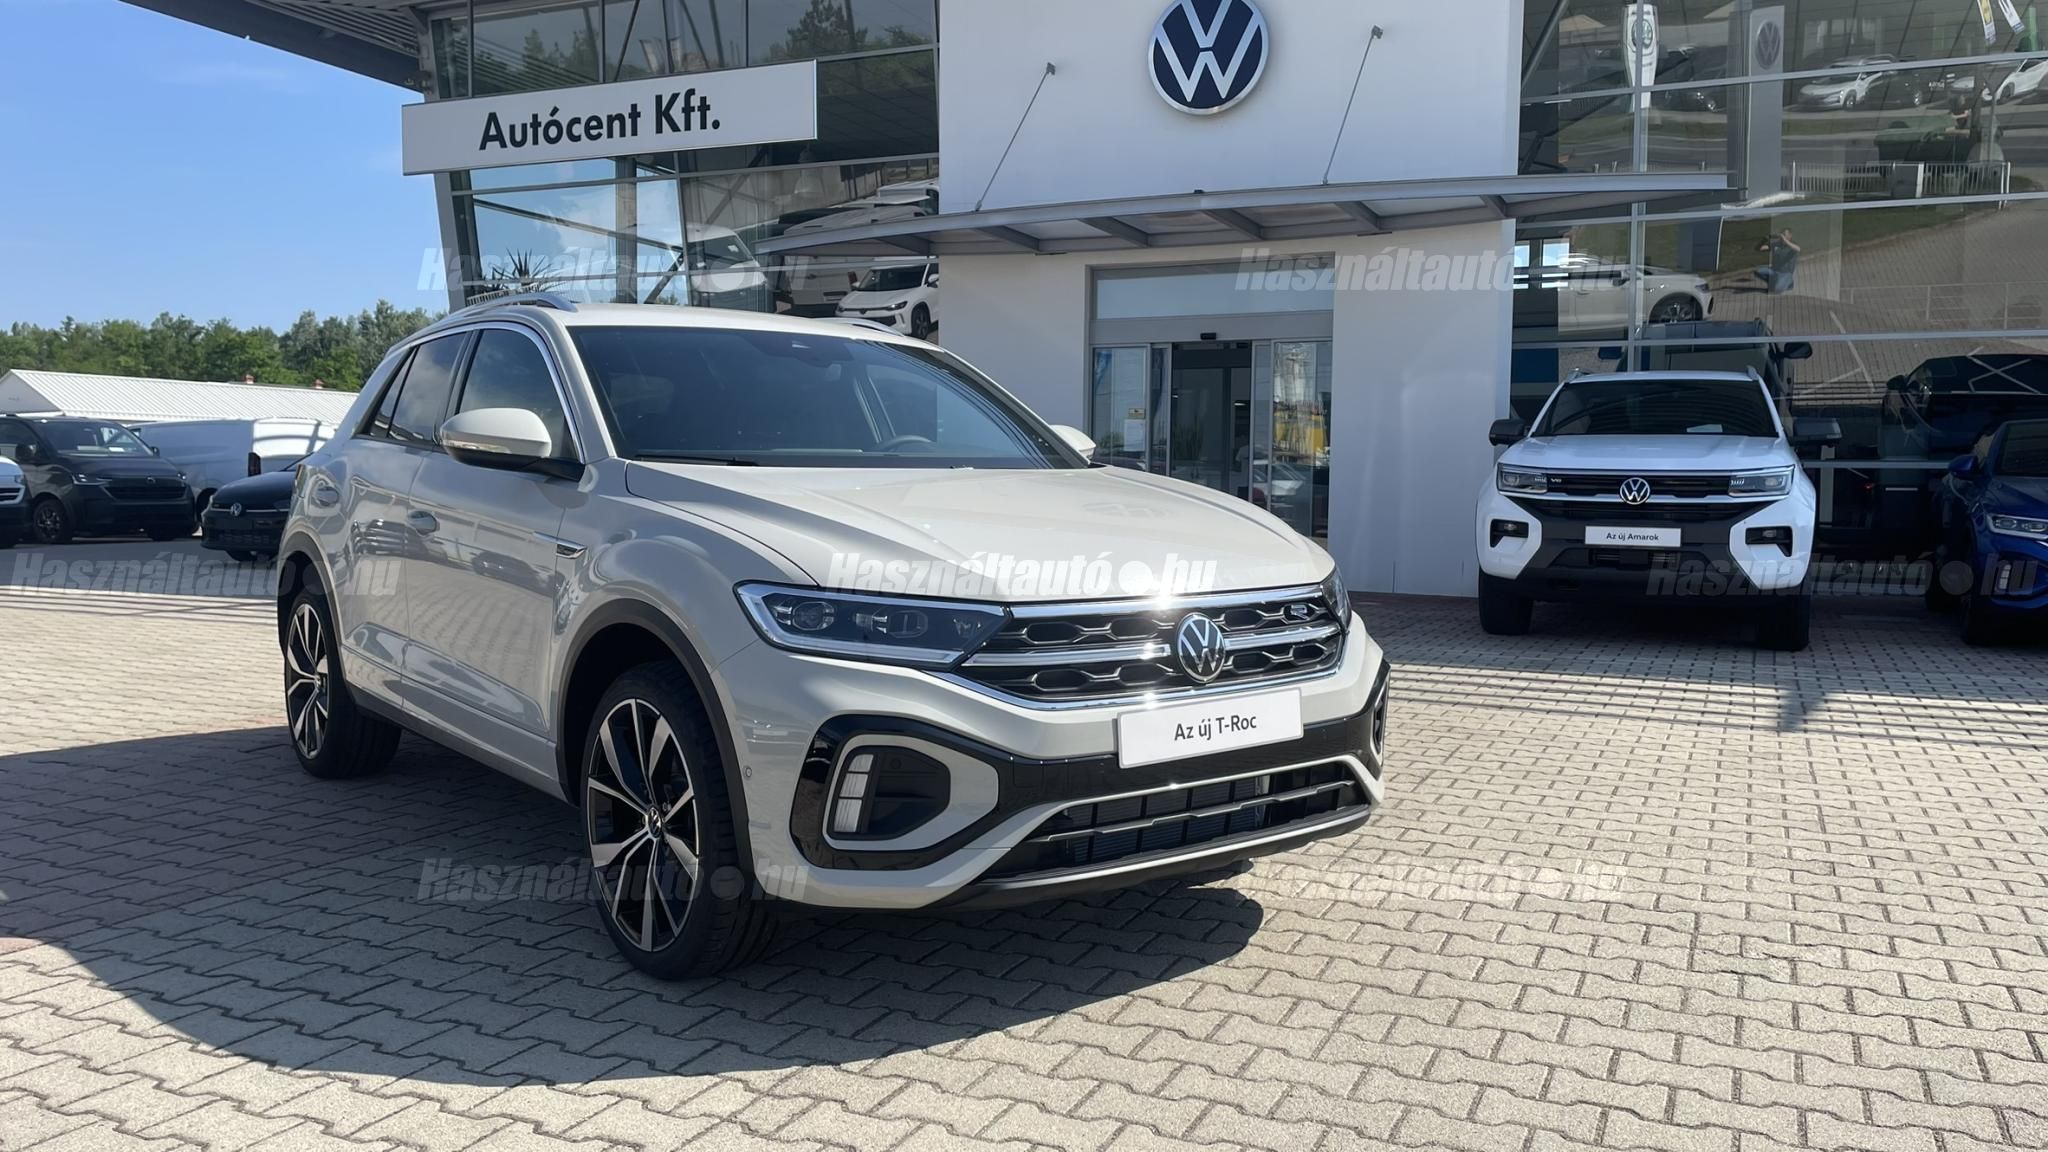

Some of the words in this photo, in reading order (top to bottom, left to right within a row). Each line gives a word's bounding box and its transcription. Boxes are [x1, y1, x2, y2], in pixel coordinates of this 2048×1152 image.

[479, 103, 642, 151] Autócent
[654, 88, 721, 135] Kft.
[1606, 532, 1616, 540] Az
[1618, 532, 1626, 542] új
[1627, 533, 1659, 541] Amarok
[1174, 723, 1194, 741] Az
[1198, 719, 1212, 741] új
[1216, 714, 1257, 734] T-Roc
